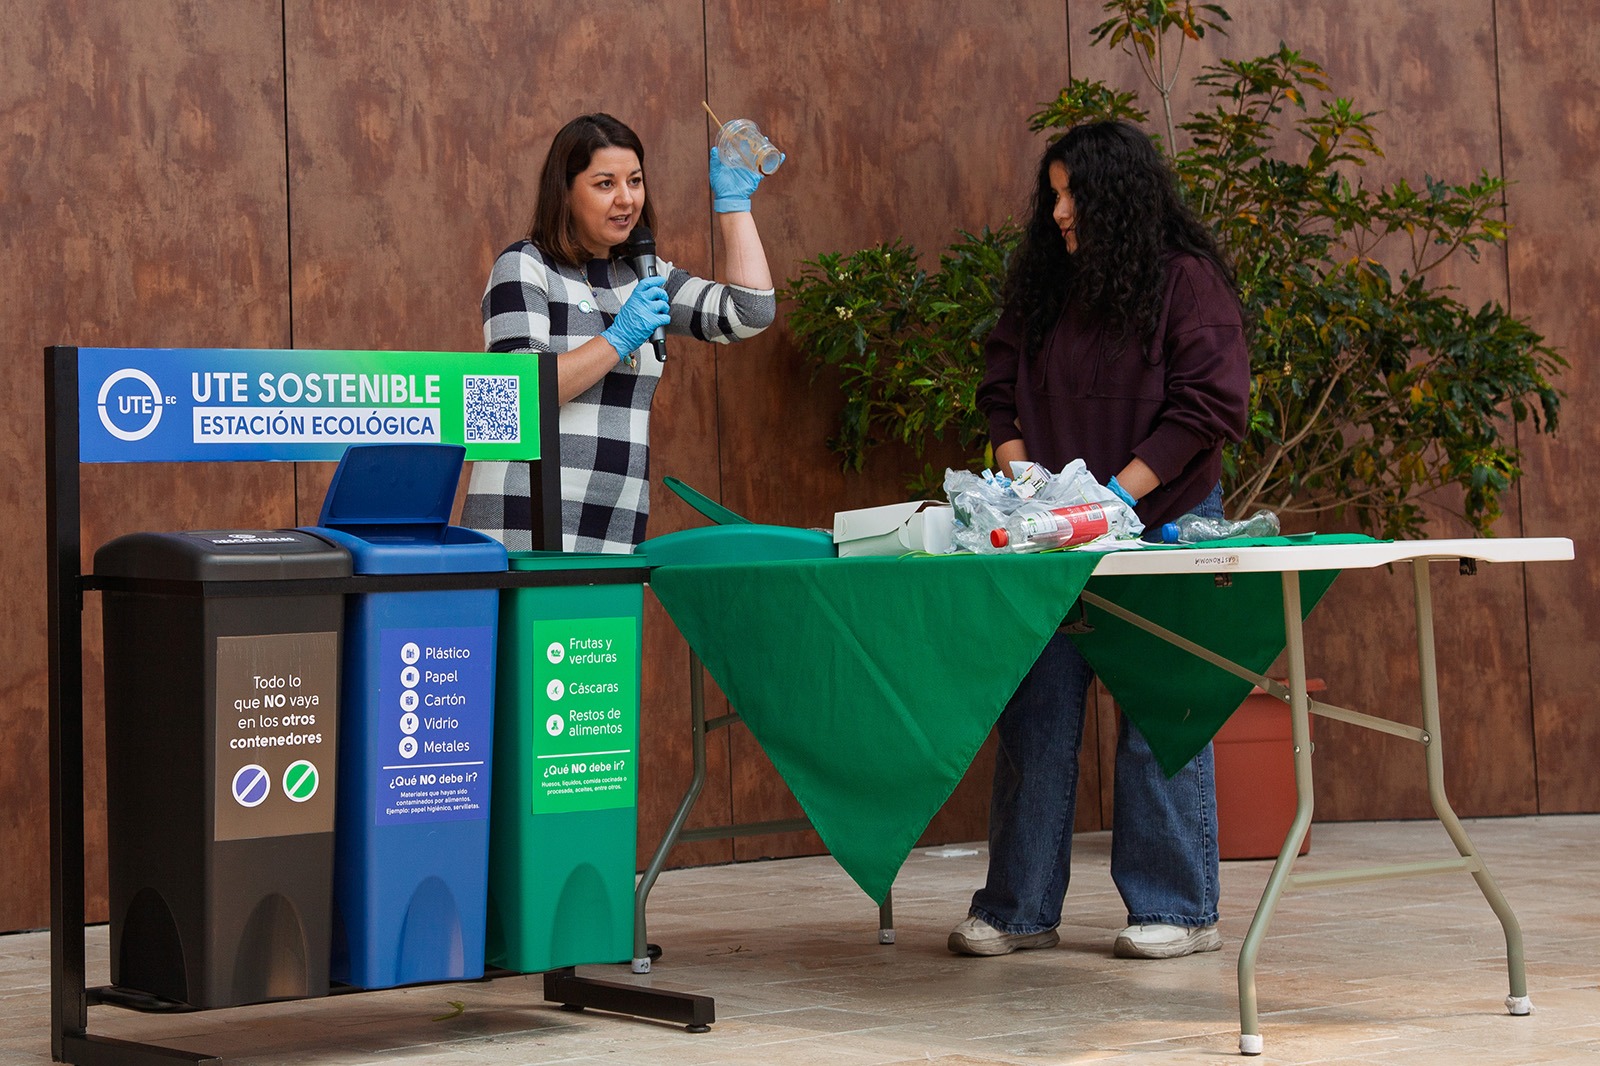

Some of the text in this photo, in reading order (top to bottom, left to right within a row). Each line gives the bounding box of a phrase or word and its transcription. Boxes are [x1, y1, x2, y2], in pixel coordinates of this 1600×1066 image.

[192, 372, 440, 404] UTE SOSTENIBLE
[118, 395, 152, 415] UTE
[166, 396, 177, 405] EC
[200, 410, 435, 435] ESTACIÓN ECOLÓGICA
[569, 638, 612, 652] Frutas y
[425, 647, 470, 659] Plástico
[569, 652, 617, 664] verduras
[253, 674, 301, 689] Todo lo
[425, 670, 458, 685] Papel
[569, 682, 619, 694] Cáscaras
[234, 692, 320, 712] que NO vaya
[424, 694, 466, 706] Cartón
[238, 713, 316, 728] en los otros
[570, 708, 621, 721] Restos de
[424, 717, 458, 729] Vidrio
[569, 722, 622, 736] alimentos
[230, 732, 322, 749] contenedores
[424, 740, 470, 753] Metales
[543, 760, 624, 778] ¿Qué NO debe ir?
[389, 772, 478, 789] ¿Qué NO debe ir?
